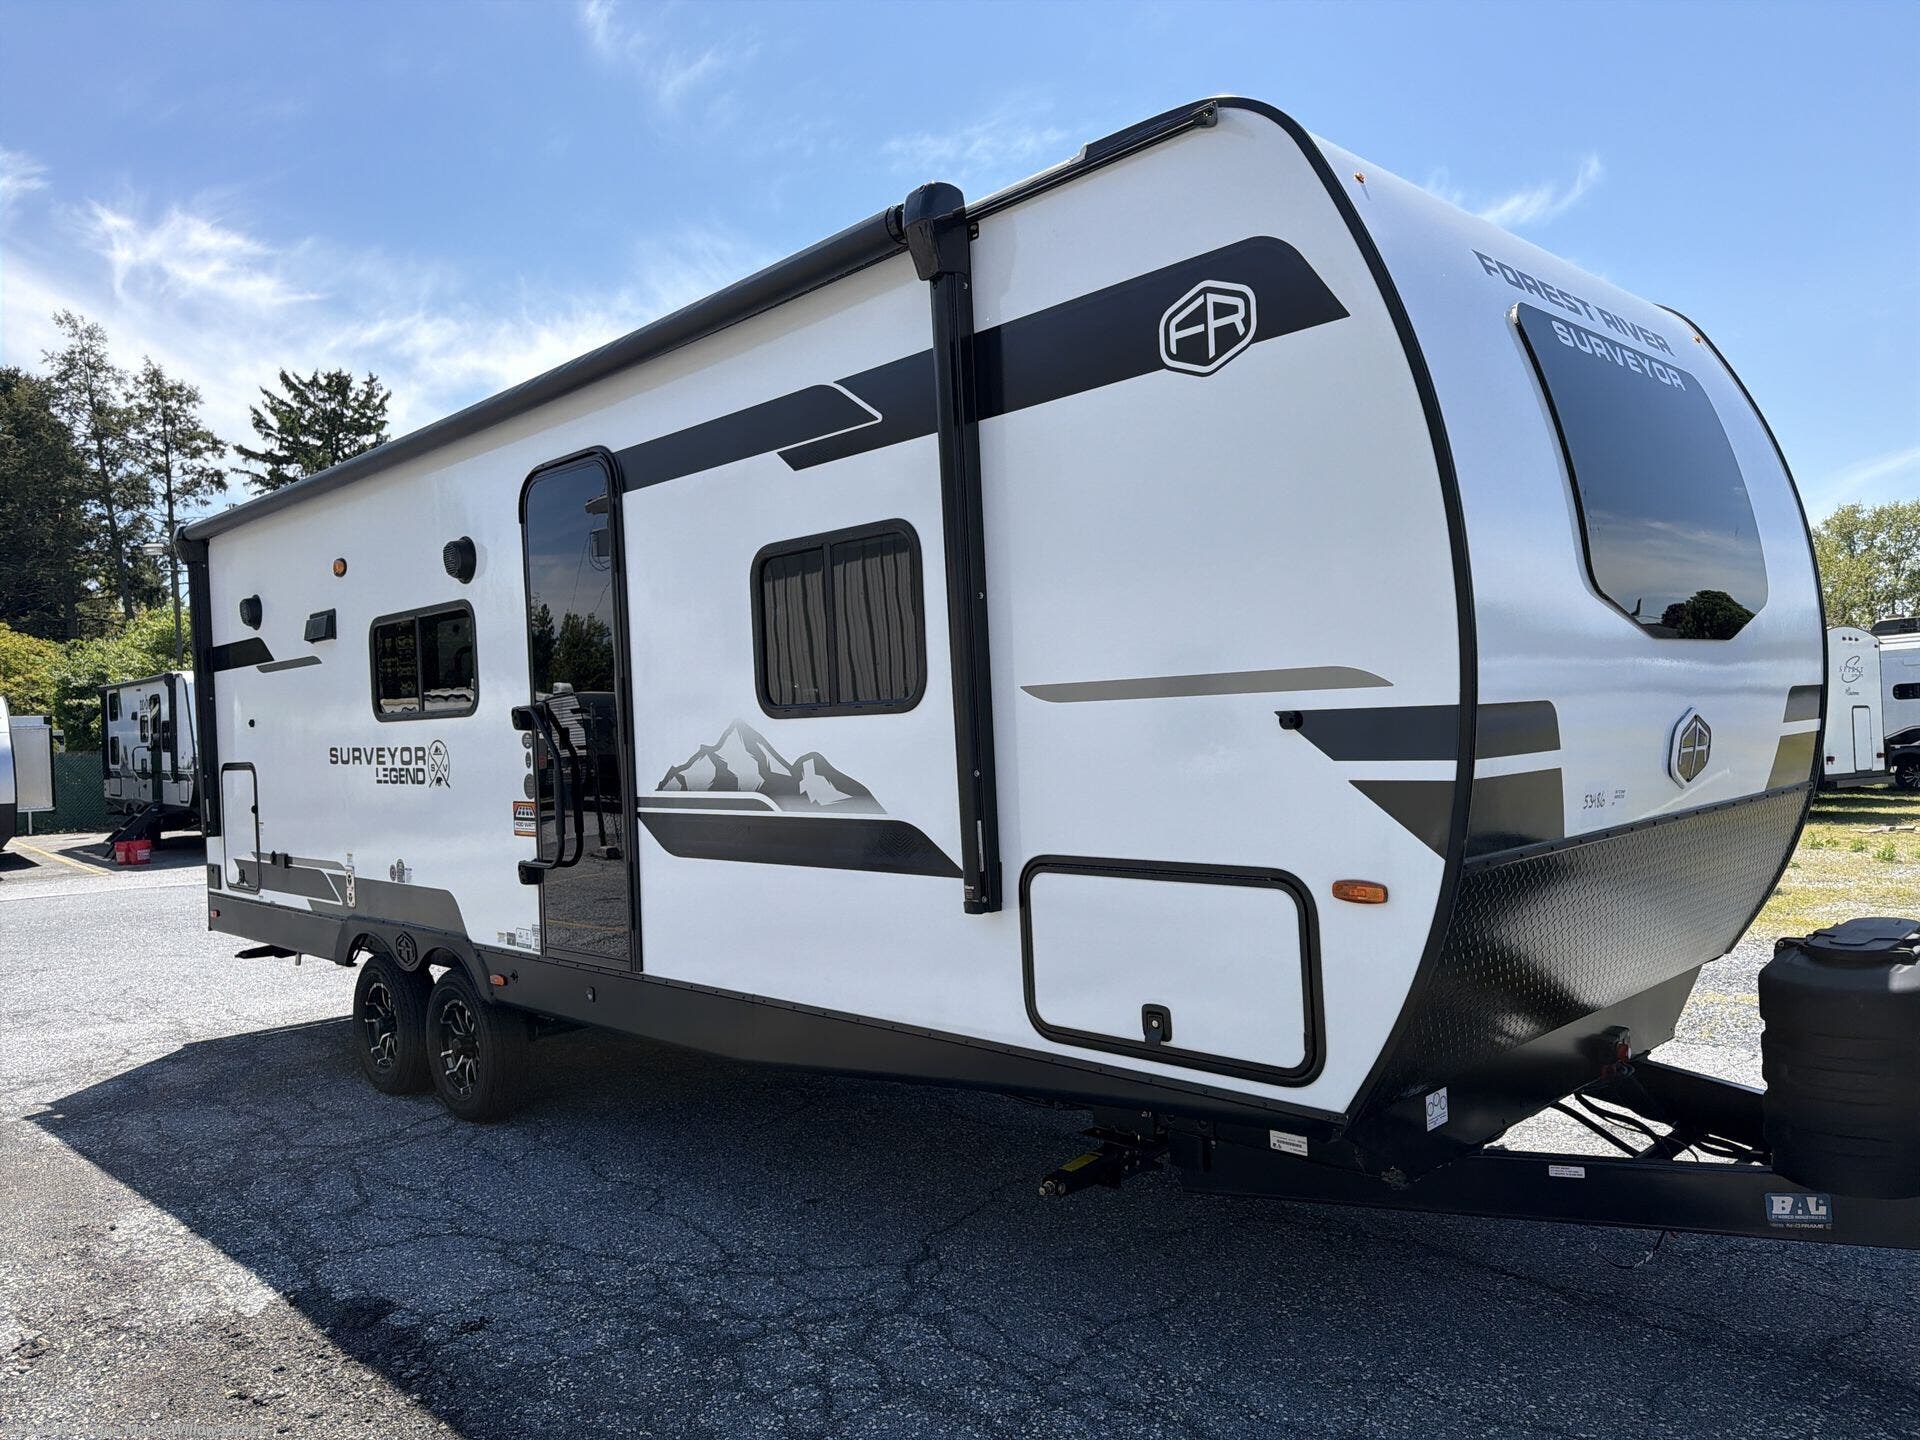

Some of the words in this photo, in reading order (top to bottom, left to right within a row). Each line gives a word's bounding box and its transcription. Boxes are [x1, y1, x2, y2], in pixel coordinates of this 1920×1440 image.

[1471, 249, 1596, 321] FOREST
[1594, 305, 1676, 357] RIVER
[1551, 320, 1686, 391] SURVEYOR
[329, 746, 427, 766] SURVEYOR
[375, 767, 426, 785] LEGEND
[1771, 1196, 1827, 1215] BAL
